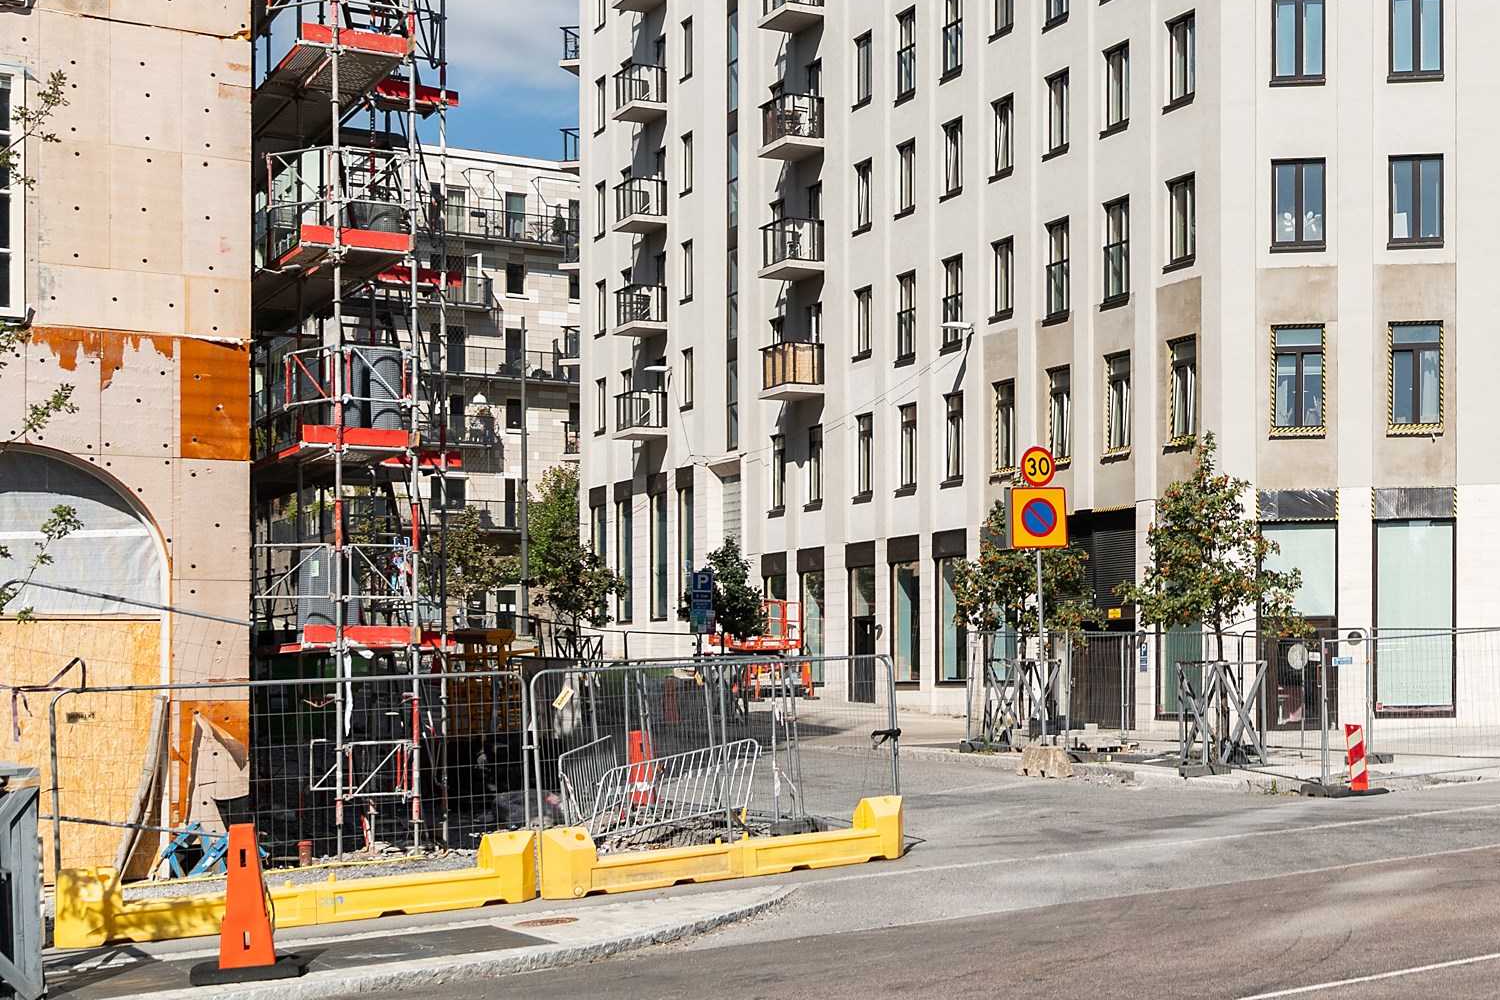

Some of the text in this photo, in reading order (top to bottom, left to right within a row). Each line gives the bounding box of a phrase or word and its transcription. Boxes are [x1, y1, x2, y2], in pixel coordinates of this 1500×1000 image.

[1027, 457, 1050, 476] 30
[698, 574, 709, 589] P
[1141, 643, 1147, 656] P
